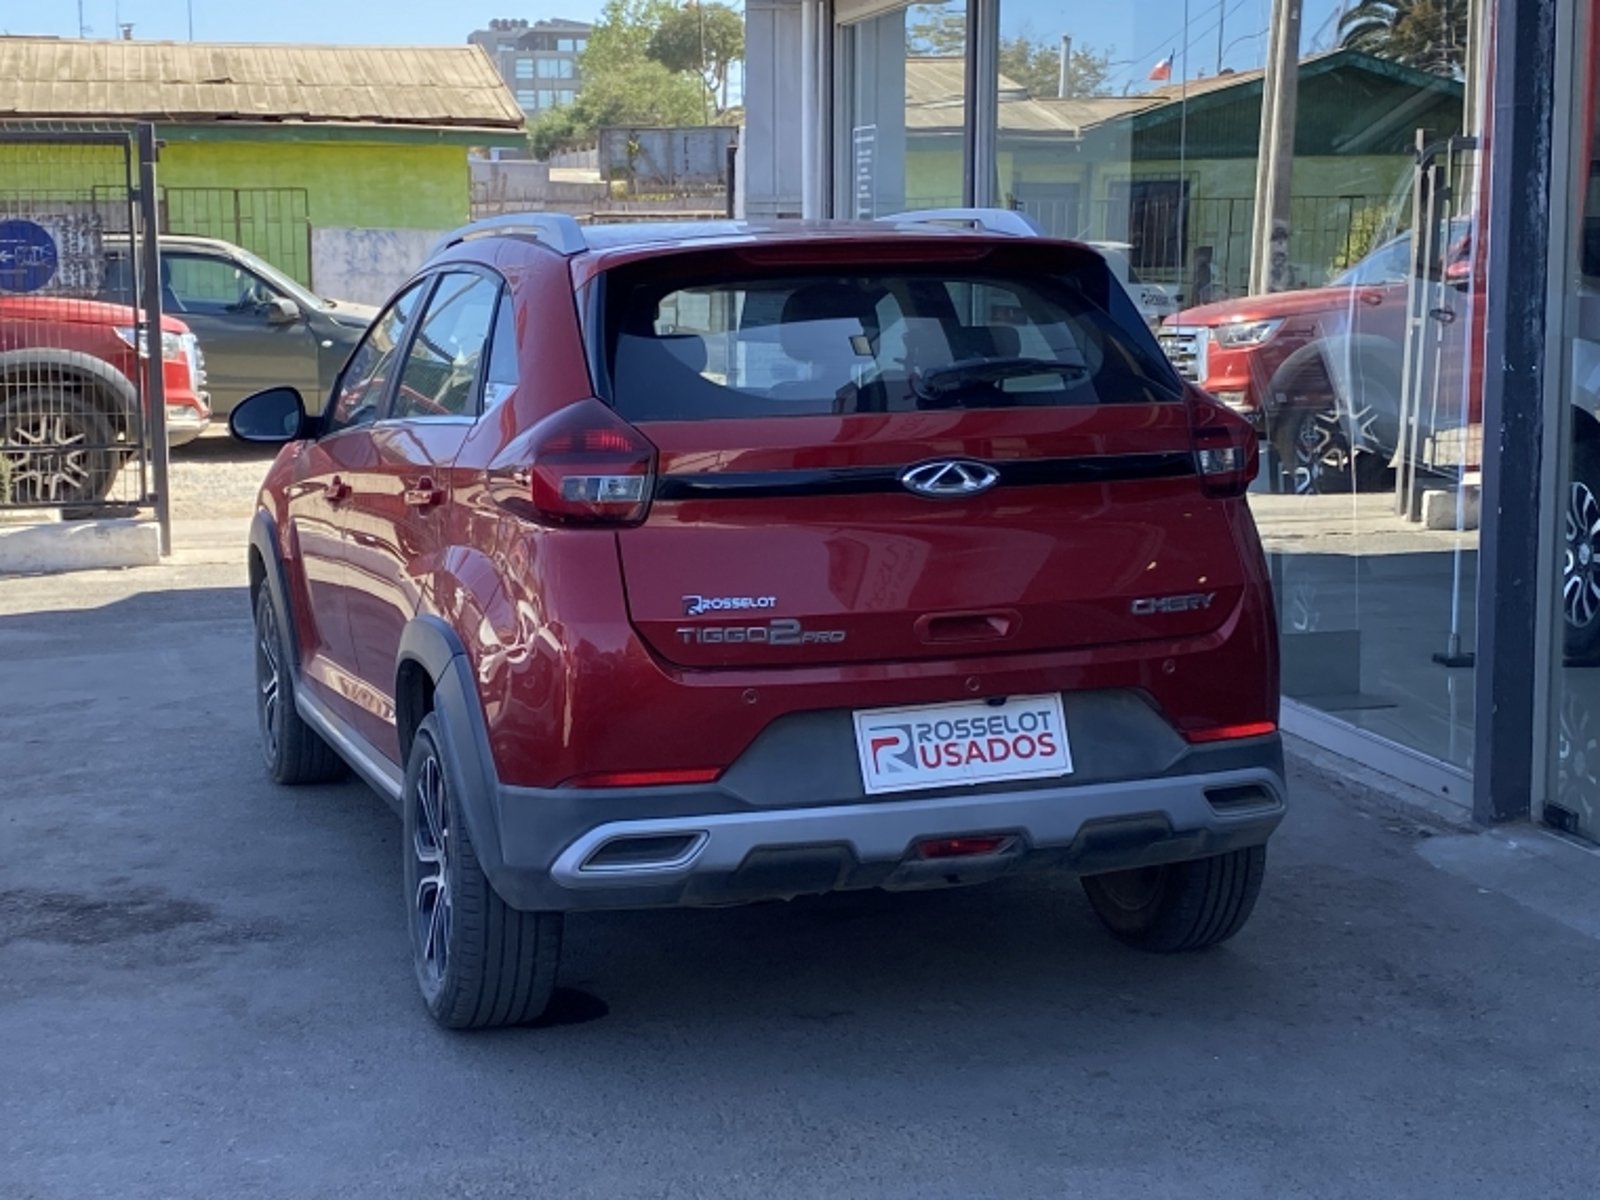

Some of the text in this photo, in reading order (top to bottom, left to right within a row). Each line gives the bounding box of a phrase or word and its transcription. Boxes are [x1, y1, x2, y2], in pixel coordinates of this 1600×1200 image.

[702, 597, 777, 609] ROSSELOT
[1131, 592, 1216, 615] CHERY
[916, 711, 1051, 743] ROSSELOT
[920, 732, 1057, 769] USADOS
